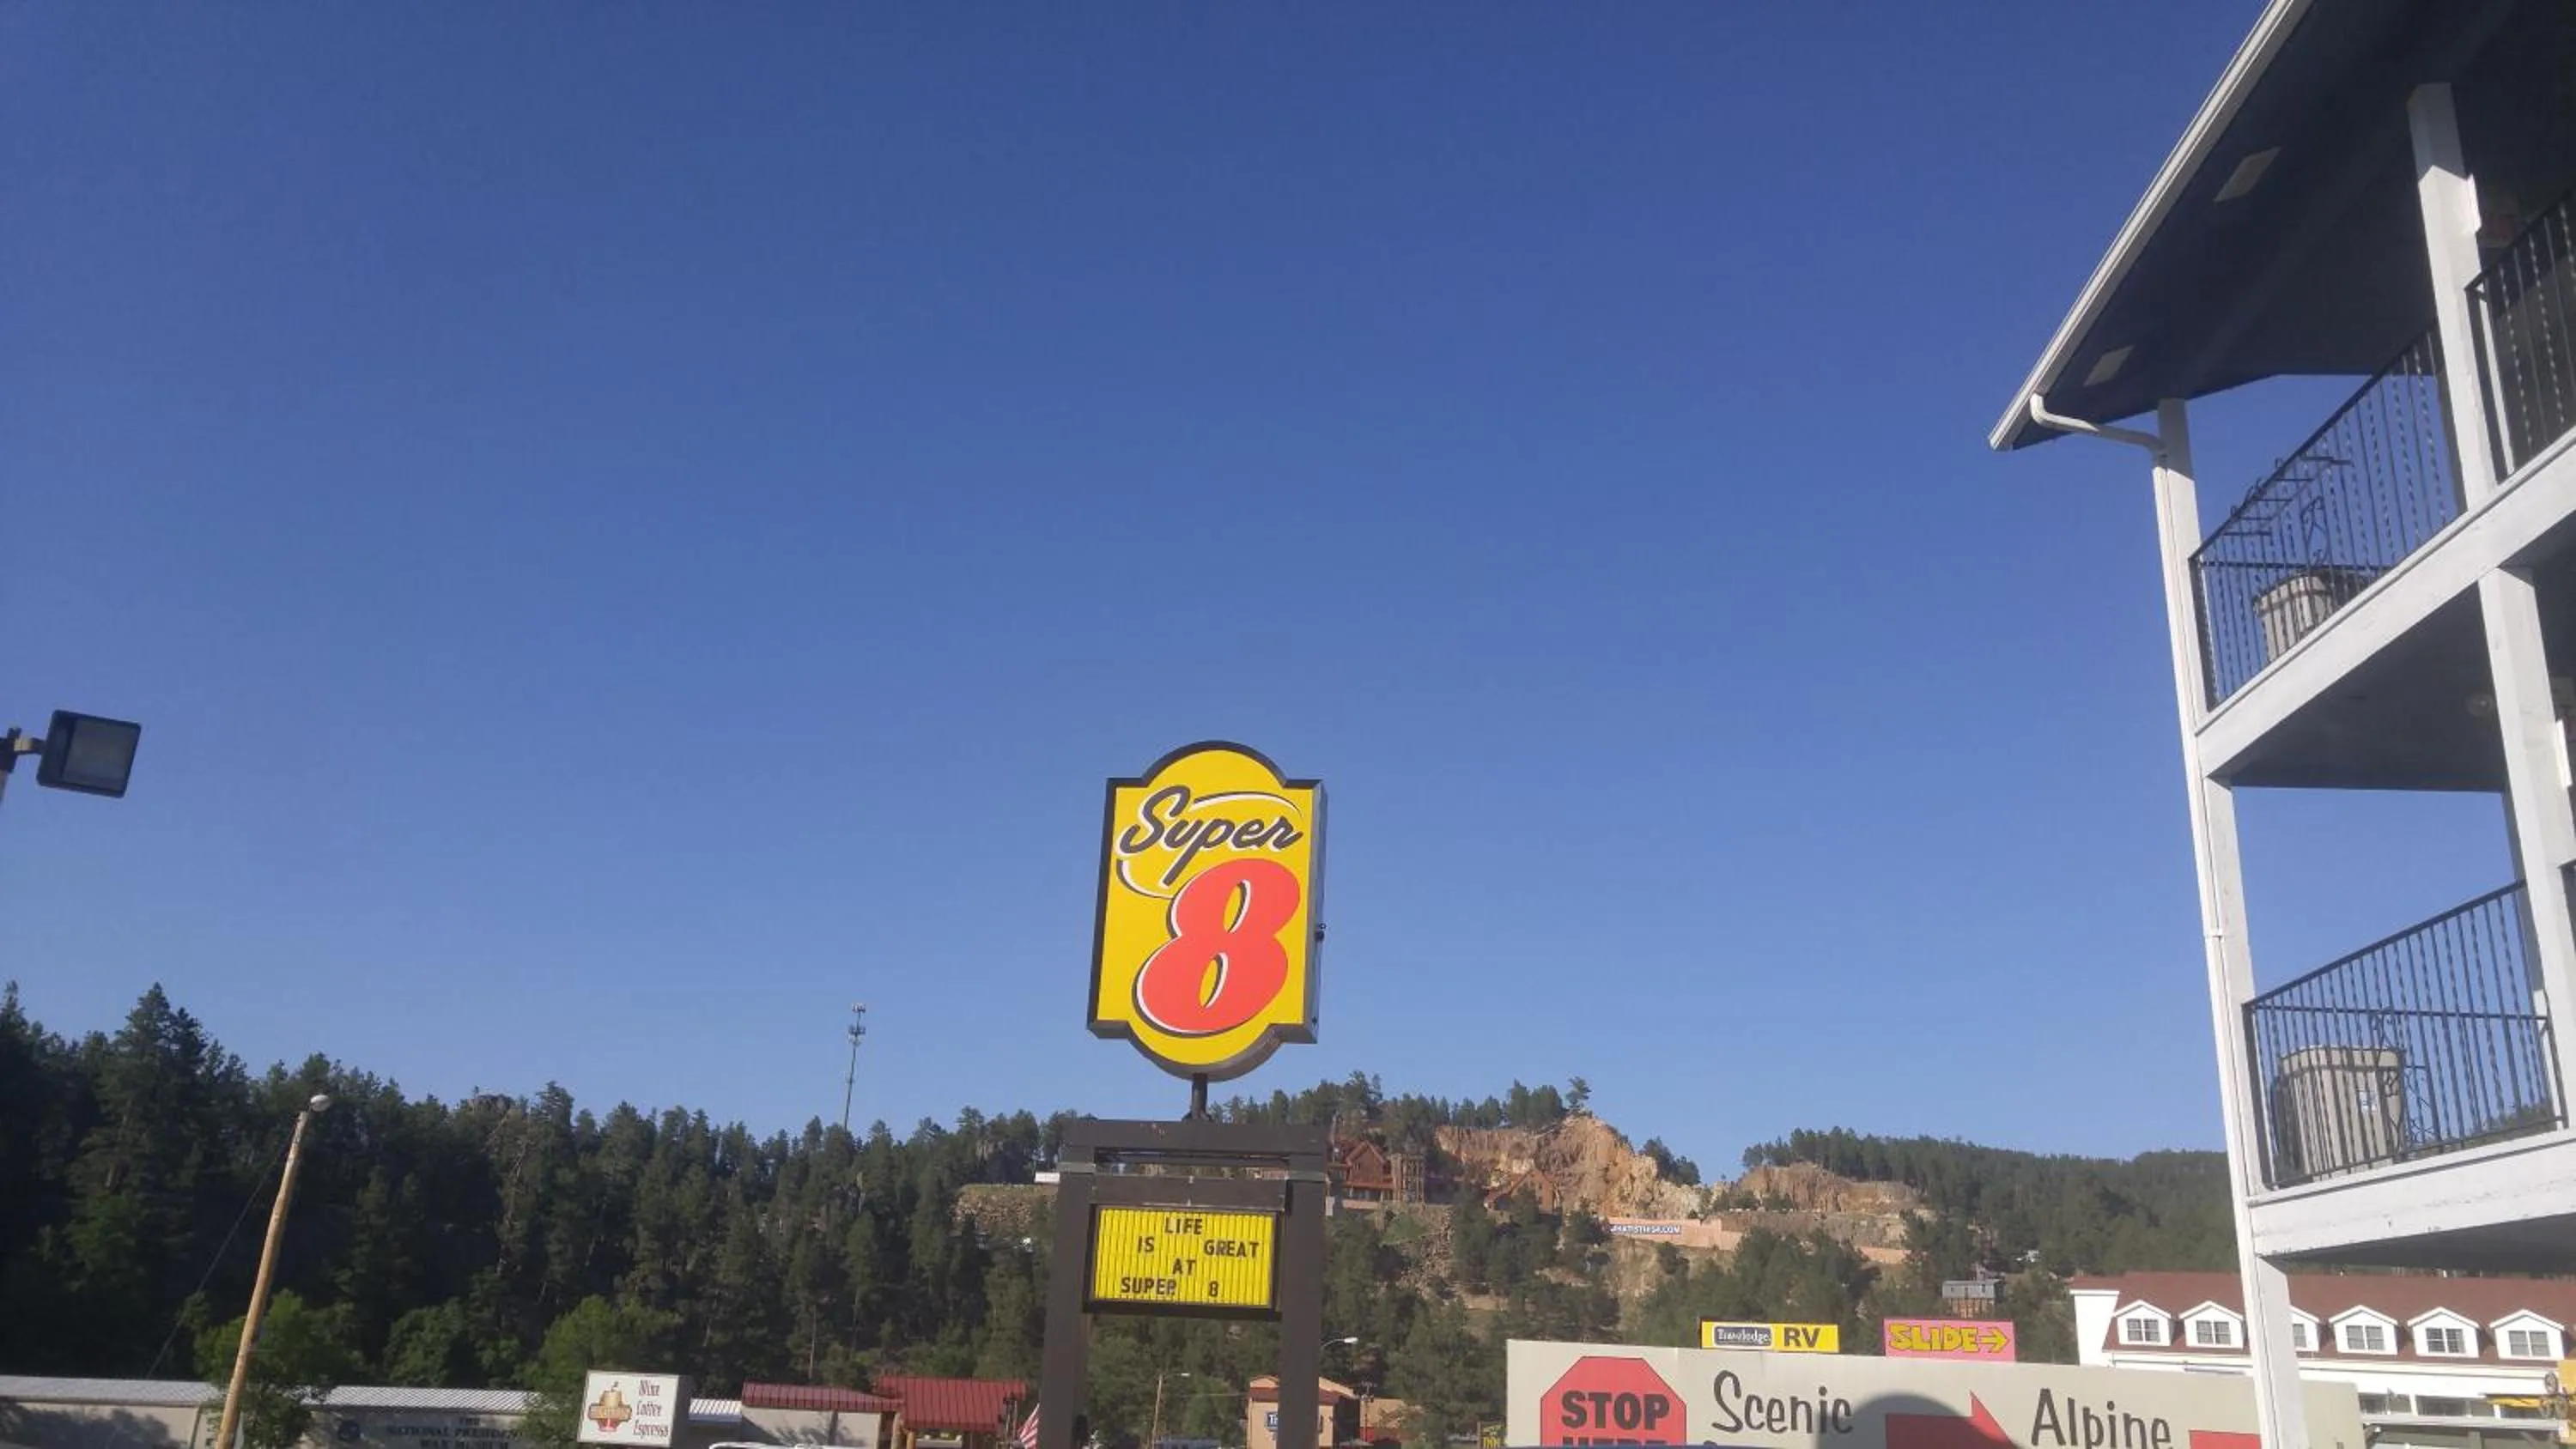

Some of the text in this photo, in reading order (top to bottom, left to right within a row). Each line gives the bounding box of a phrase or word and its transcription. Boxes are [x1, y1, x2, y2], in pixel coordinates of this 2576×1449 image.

[1116, 785, 1303, 888] Super
[1132, 858, 1300, 1037] 8
[1164, 1217, 1202, 1235] LIFE
[1137, 1236, 1259, 1258] IS GREAT
[1172, 1258, 1196, 1275] AT
[1120, 1276, 1219, 1298] SUPER 8
[1783, 1327, 1820, 1348] RV
[1889, 1324, 1980, 1353] SLIDE
[1560, 1390, 1670, 1431] STOP
[1710, 1370, 2173, 1449] Scenic Alpine
